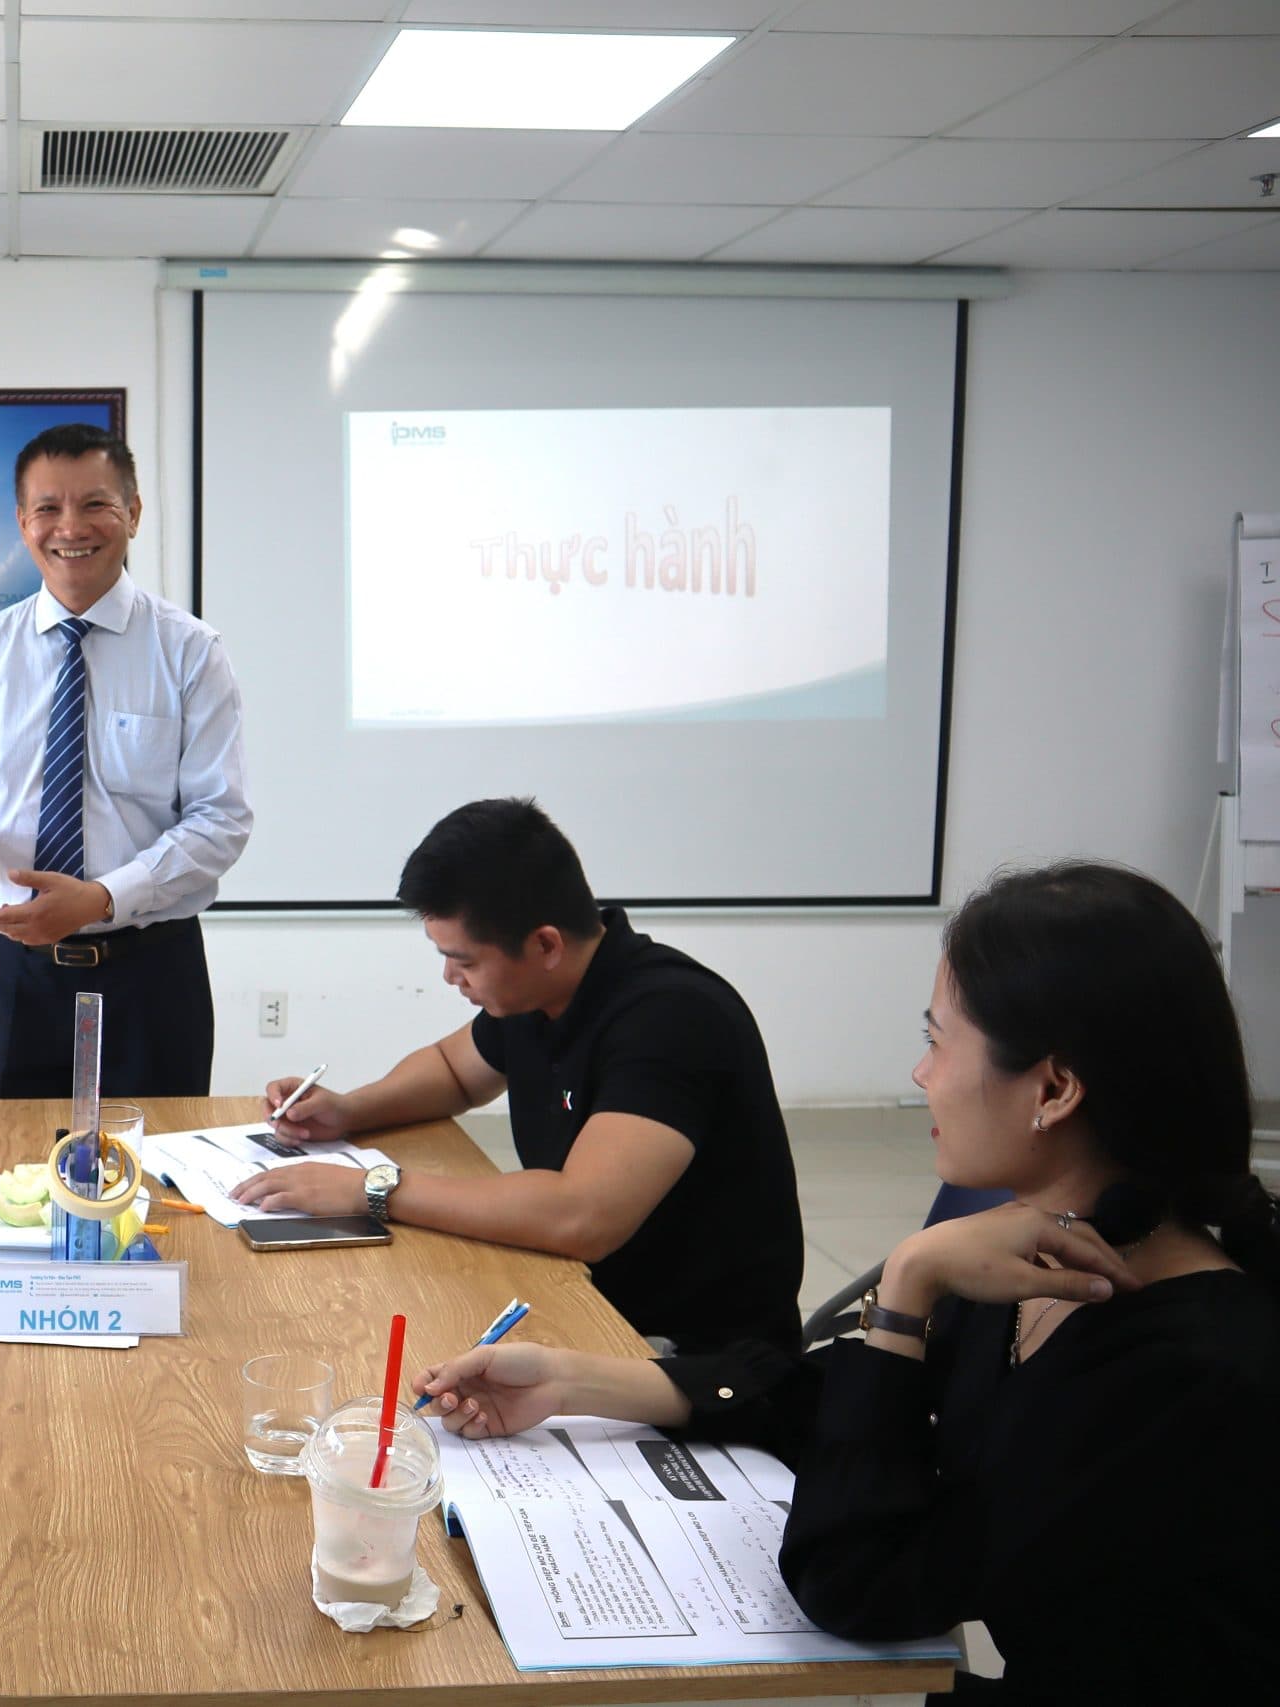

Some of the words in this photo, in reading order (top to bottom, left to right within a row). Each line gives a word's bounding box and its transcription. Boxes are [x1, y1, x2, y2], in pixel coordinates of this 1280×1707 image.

[469, 530, 609, 595] Thực
[624, 494, 756, 599] hành
[20, 1305, 99, 1330] NHÓM
[108, 1311, 122, 1330] 2
